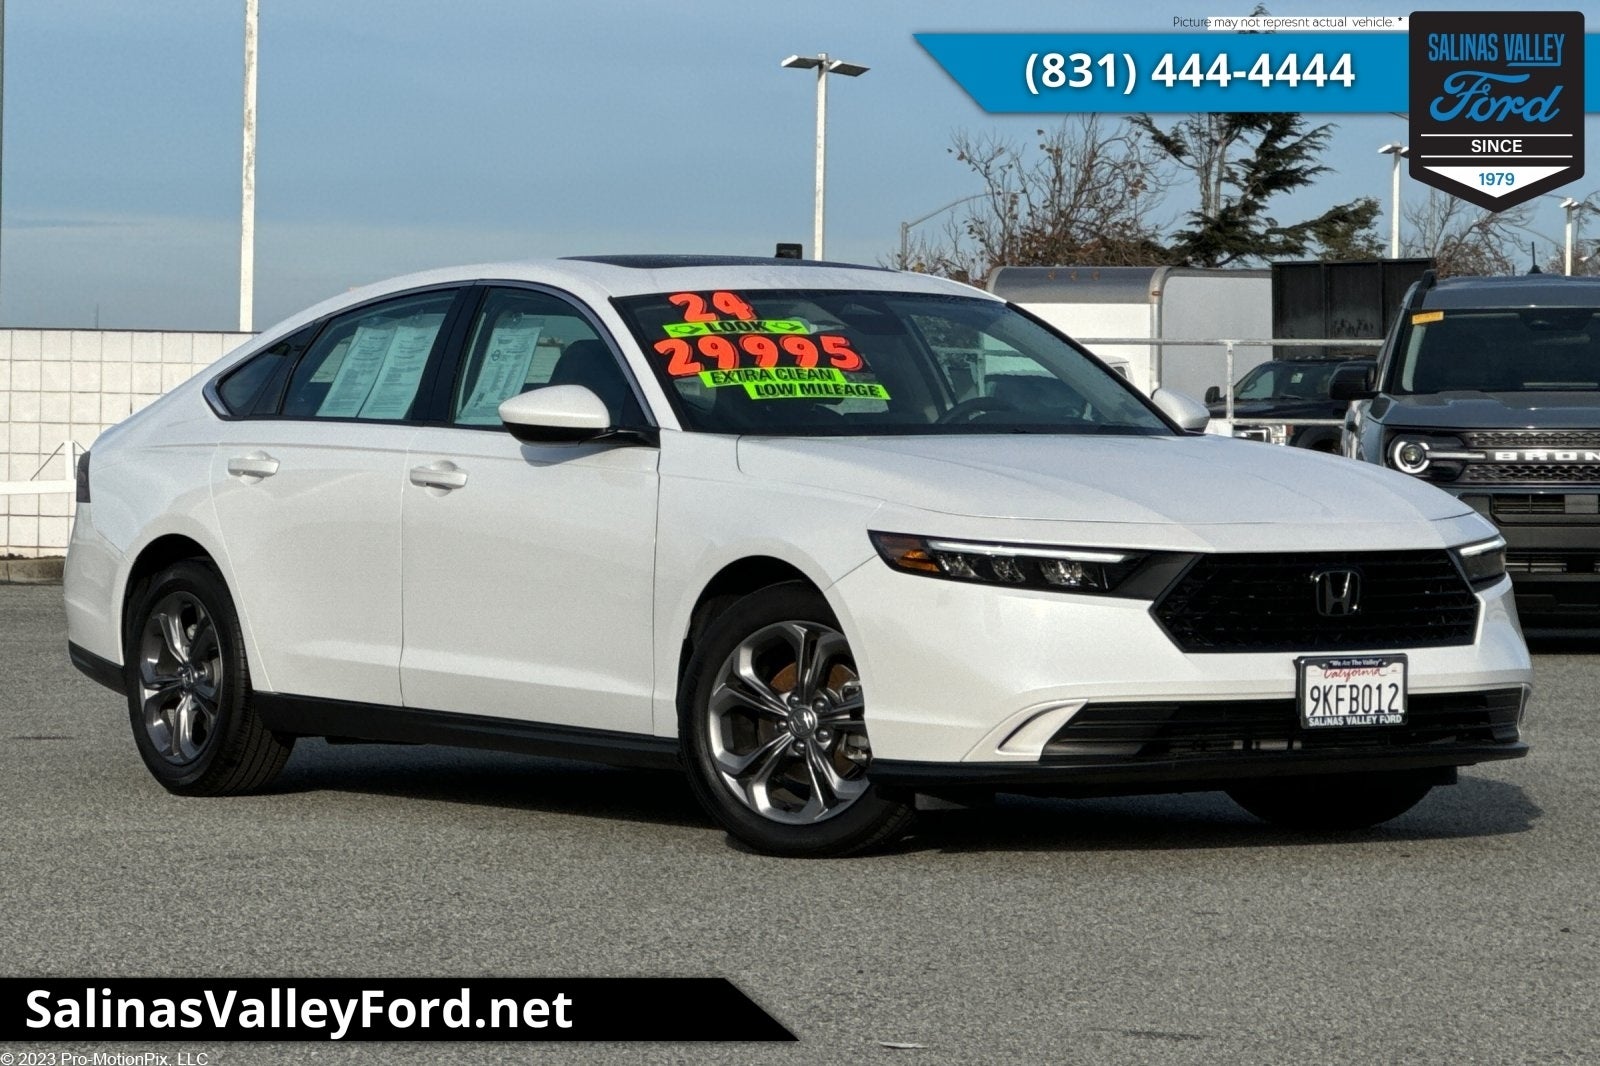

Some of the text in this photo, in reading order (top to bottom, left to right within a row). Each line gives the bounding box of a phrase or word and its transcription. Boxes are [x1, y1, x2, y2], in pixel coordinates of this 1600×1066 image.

[668, 290, 756, 322] 24
[705, 321, 767, 333] LOOK
[653, 335, 862, 376] 29995
[711, 367, 834, 384] EXTRA CLEAN
[755, 382, 881, 398] LOW MILEAGE
[1324, 668, 1387, 682] California
[1309, 683, 1399, 716] 9KFB012
[1309, 714, 1402, 726] SALINAS VALLEY FORD
